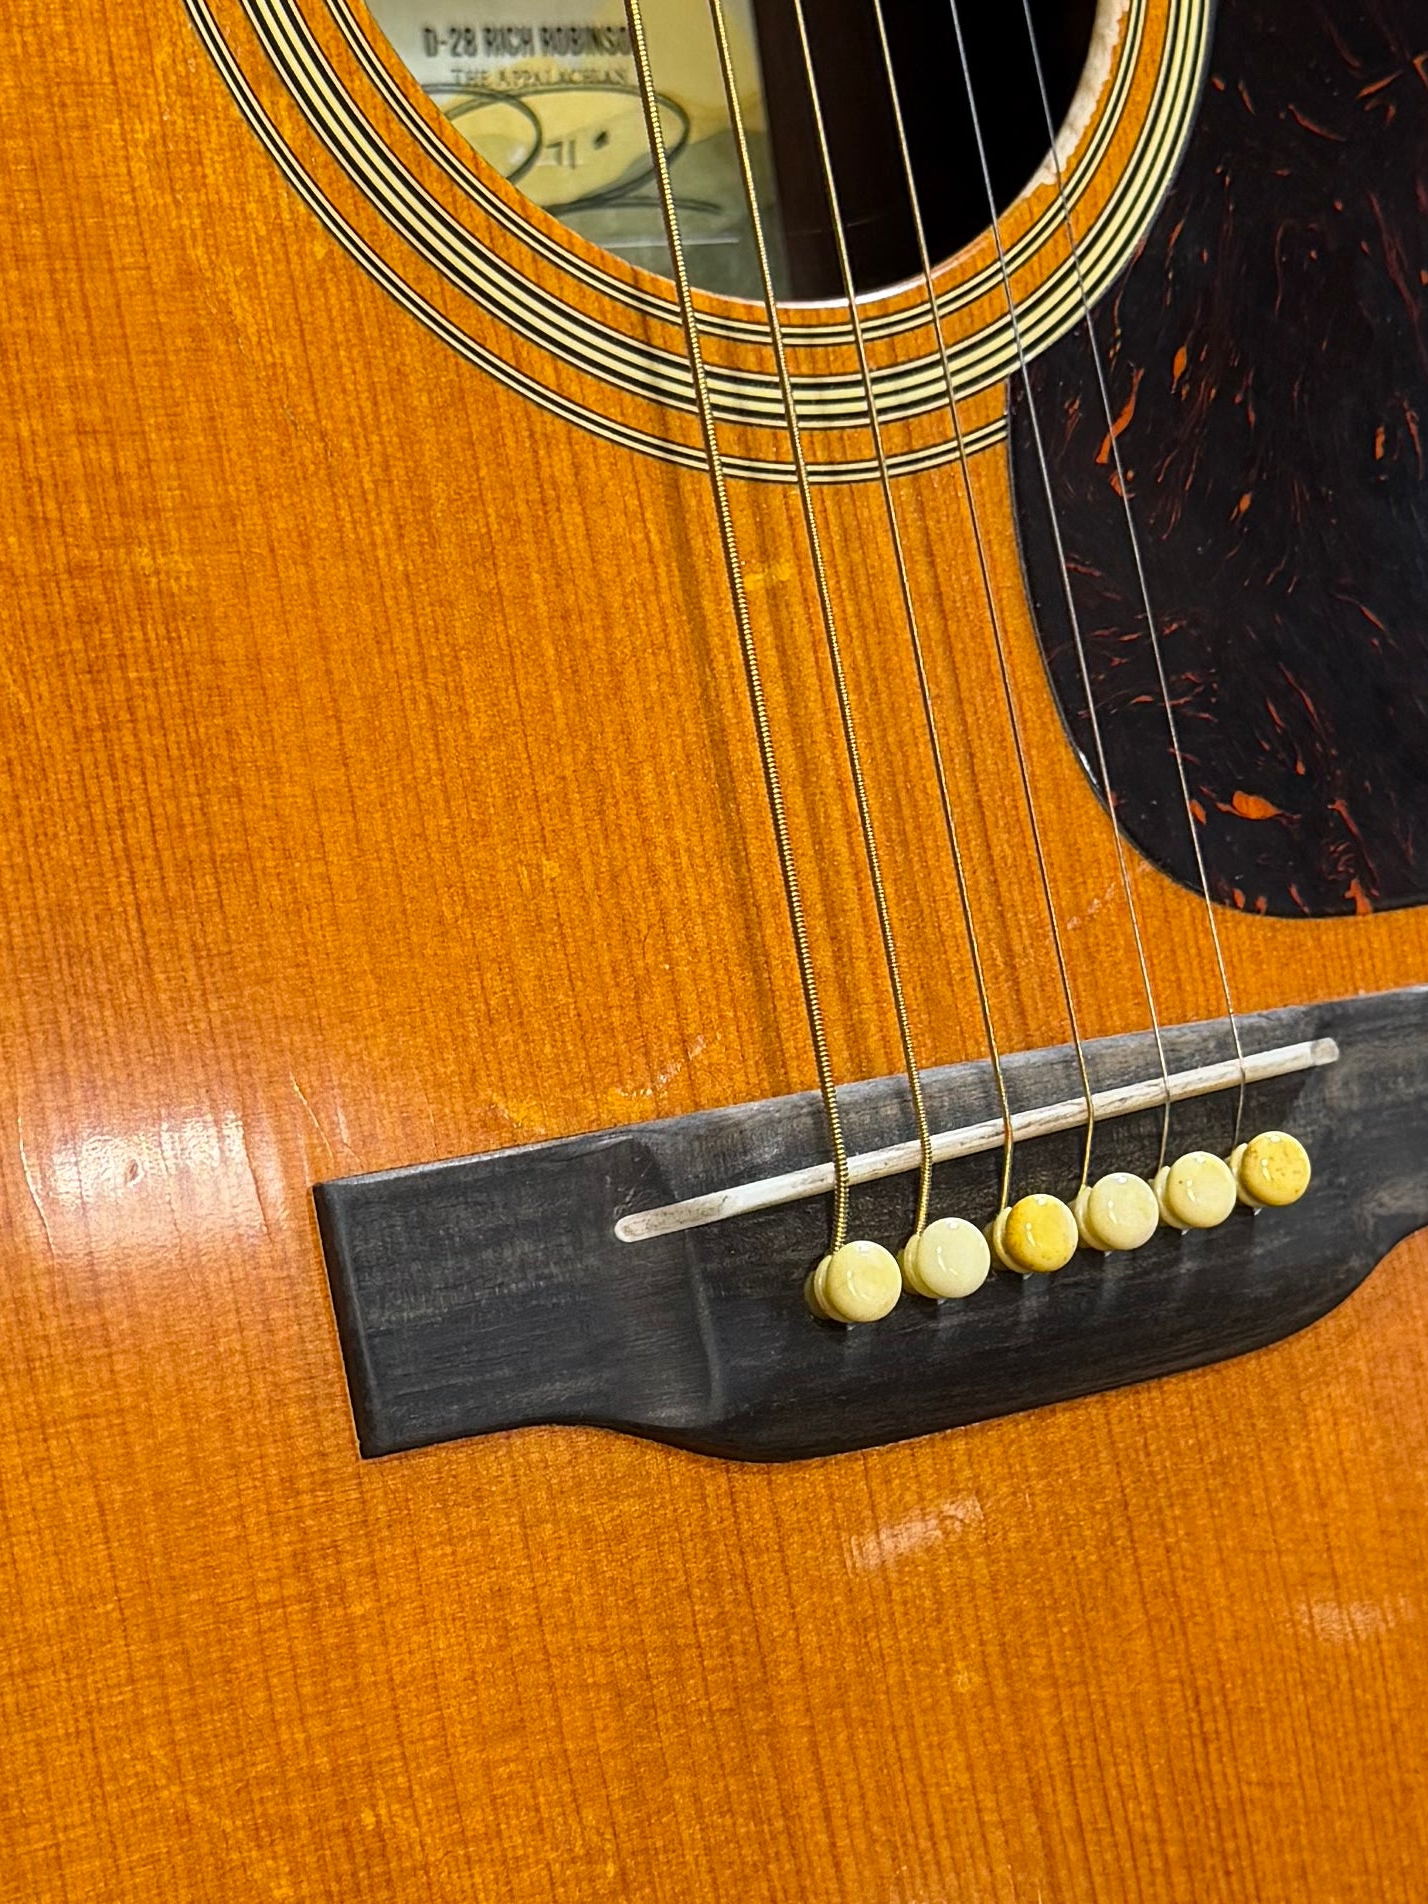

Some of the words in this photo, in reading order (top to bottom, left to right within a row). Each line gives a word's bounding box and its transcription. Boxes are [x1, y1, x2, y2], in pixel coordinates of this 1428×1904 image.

[423, 25, 478, 58] D-28
[482, 25, 535, 57] RICH
[539, 25, 634, 57] ROBINSO
